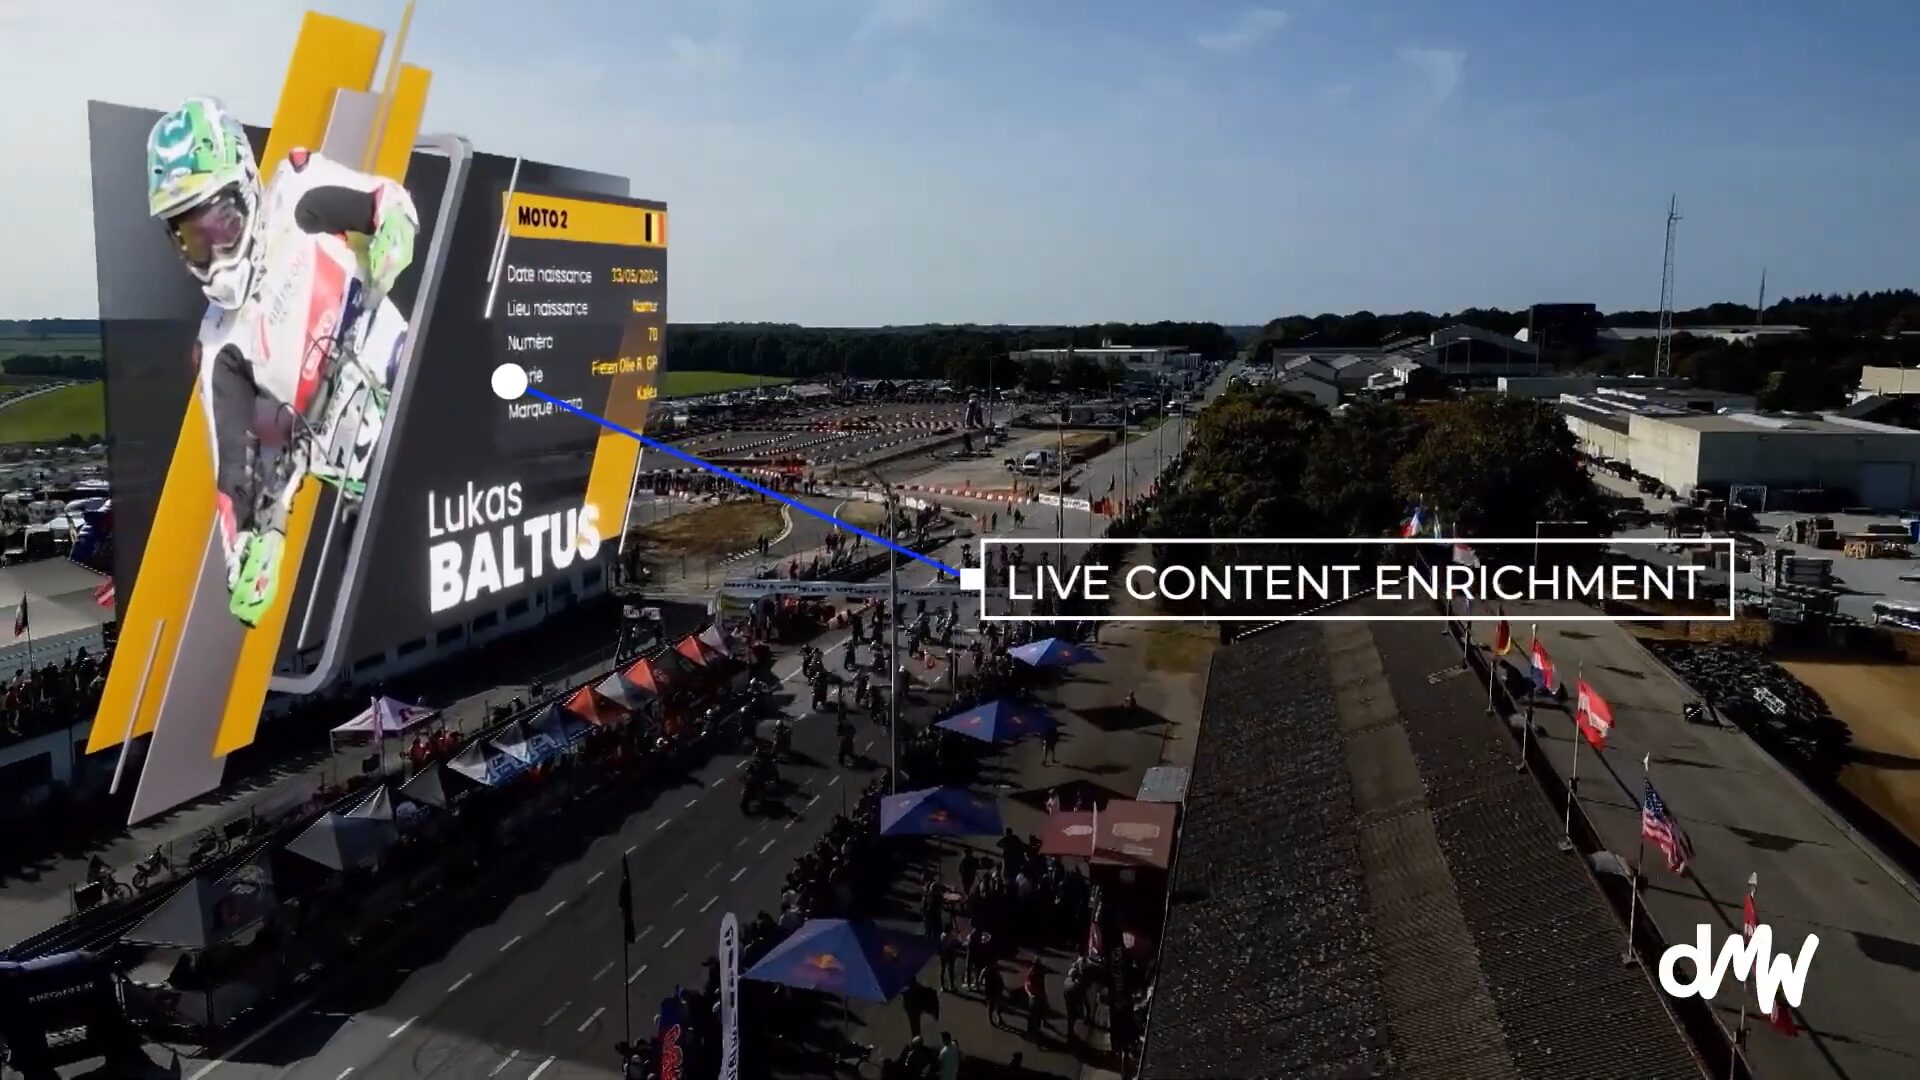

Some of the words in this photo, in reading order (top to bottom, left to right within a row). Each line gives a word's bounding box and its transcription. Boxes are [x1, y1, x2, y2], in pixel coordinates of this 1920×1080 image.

[507, 265, 535, 283] Date
[537, 265, 592, 284] naissance
[507, 300, 531, 317] Lieu
[534, 299, 588, 317] naissance
[507, 333, 554, 352] Numéro
[648, 327, 658, 342] 70
[508, 400, 553, 422] Marque
[429, 481, 522, 538] Lukas
[429, 504, 601, 614] BALTUS
